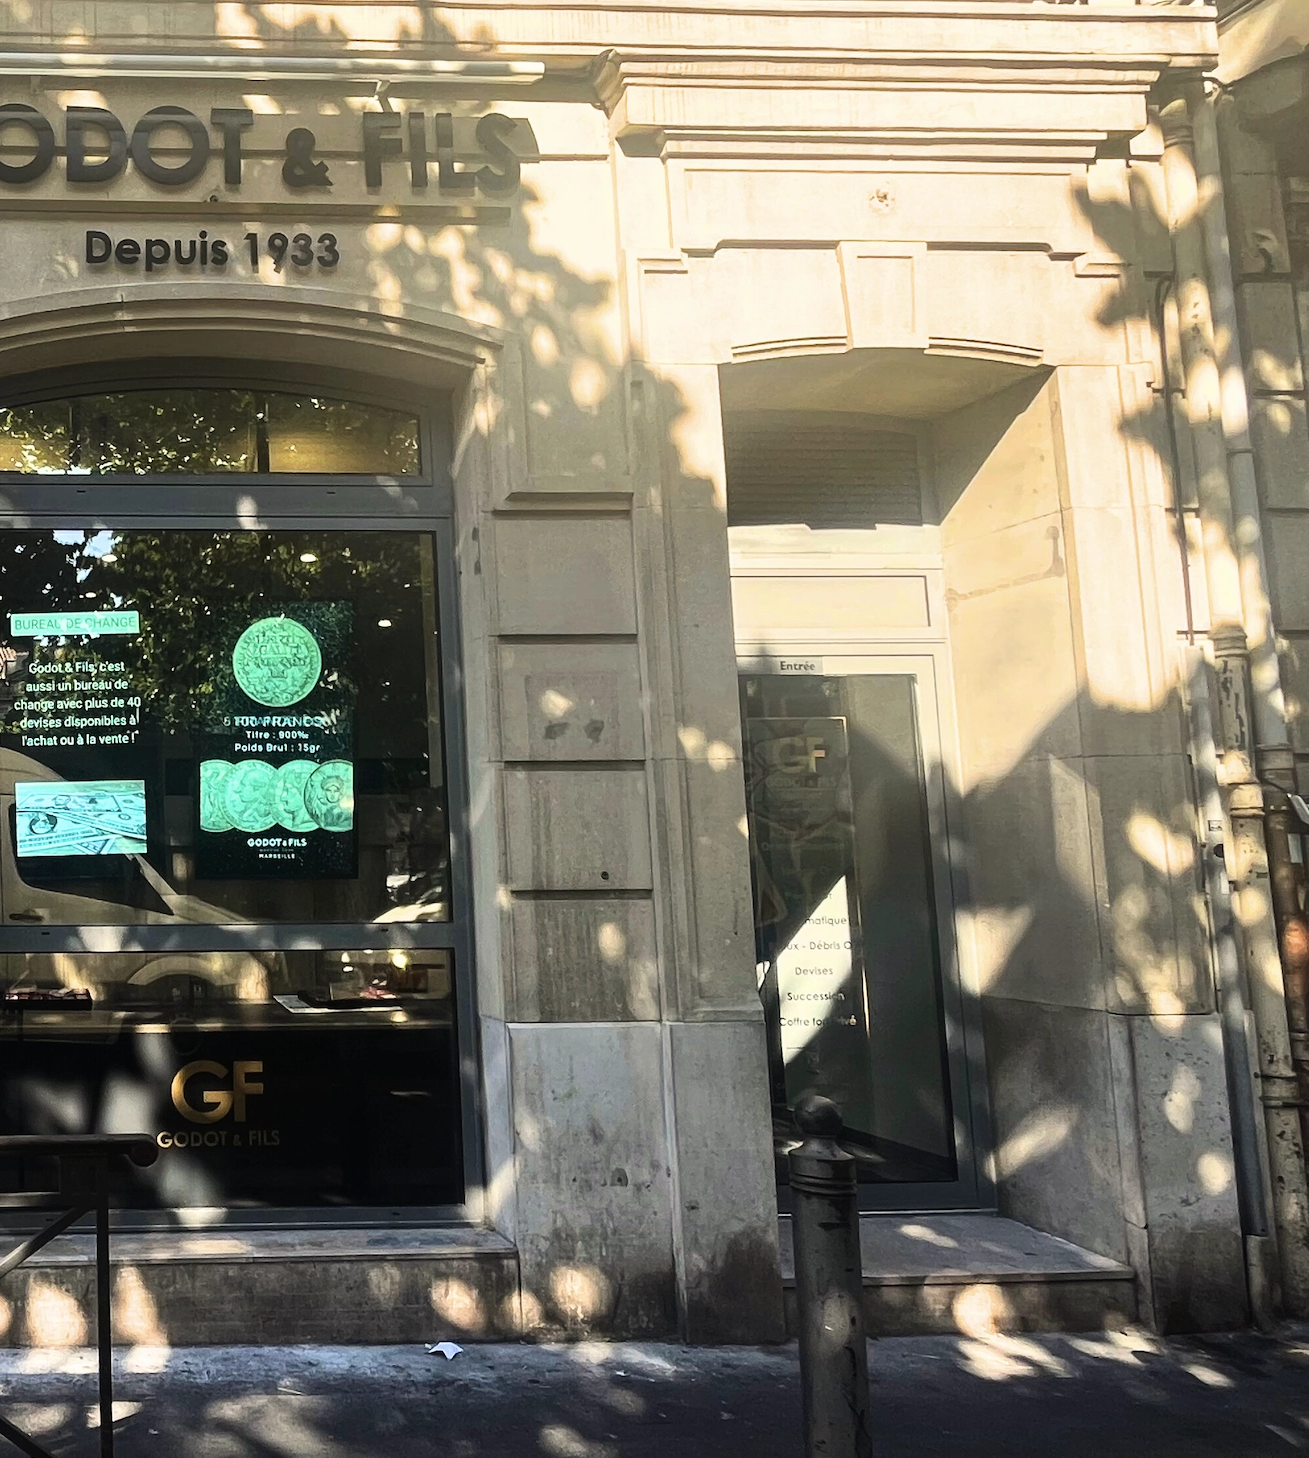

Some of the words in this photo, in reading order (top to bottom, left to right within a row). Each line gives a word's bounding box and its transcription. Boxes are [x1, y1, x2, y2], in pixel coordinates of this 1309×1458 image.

[282, 127, 333, 186] &
[363, 112, 520, 198] FILS
[85, 230, 229, 271] Depuis
[243, 231, 340, 274] 1933
[84, 615, 137, 629] CHANGE
[28, 662, 63, 675] Godot
[64, 662, 73, 673] &
[99, 660, 126, 672] c'est
[779, 660, 816, 671] Entrée
[25, 680, 56, 692] aussi
[58, 681, 72, 691] un
[73, 679, 112, 691] bureau
[114, 679, 129, 690] de
[14, 699, 55, 712] change
[56, 699, 83, 710] avec
[84, 697, 109, 711] plus
[110, 696, 125, 708] de
[126, 696, 142, 708] 40
[20, 717, 62, 729] devises
[64, 715, 127, 729] disponibles
[129, 714, 137, 726] à
[21, 734, 58, 747] l'achat
[59, 735, 75, 746] ou
[76, 733, 85, 745] à
[86, 734, 97, 745] la
[98, 734, 130, 745] vente
[245, 730, 271, 739] Titre
[234, 742, 264, 752] Poids
[266, 742, 288, 752] Brut
[809, 940, 841, 950] Débris
[795, 966, 834, 976] Devises
[171, 1060, 264, 1124] GF
[156, 1131, 227, 1149] GODOT
[232, 1134, 242, 1147] &
[248, 1130, 280, 1146] FILS
